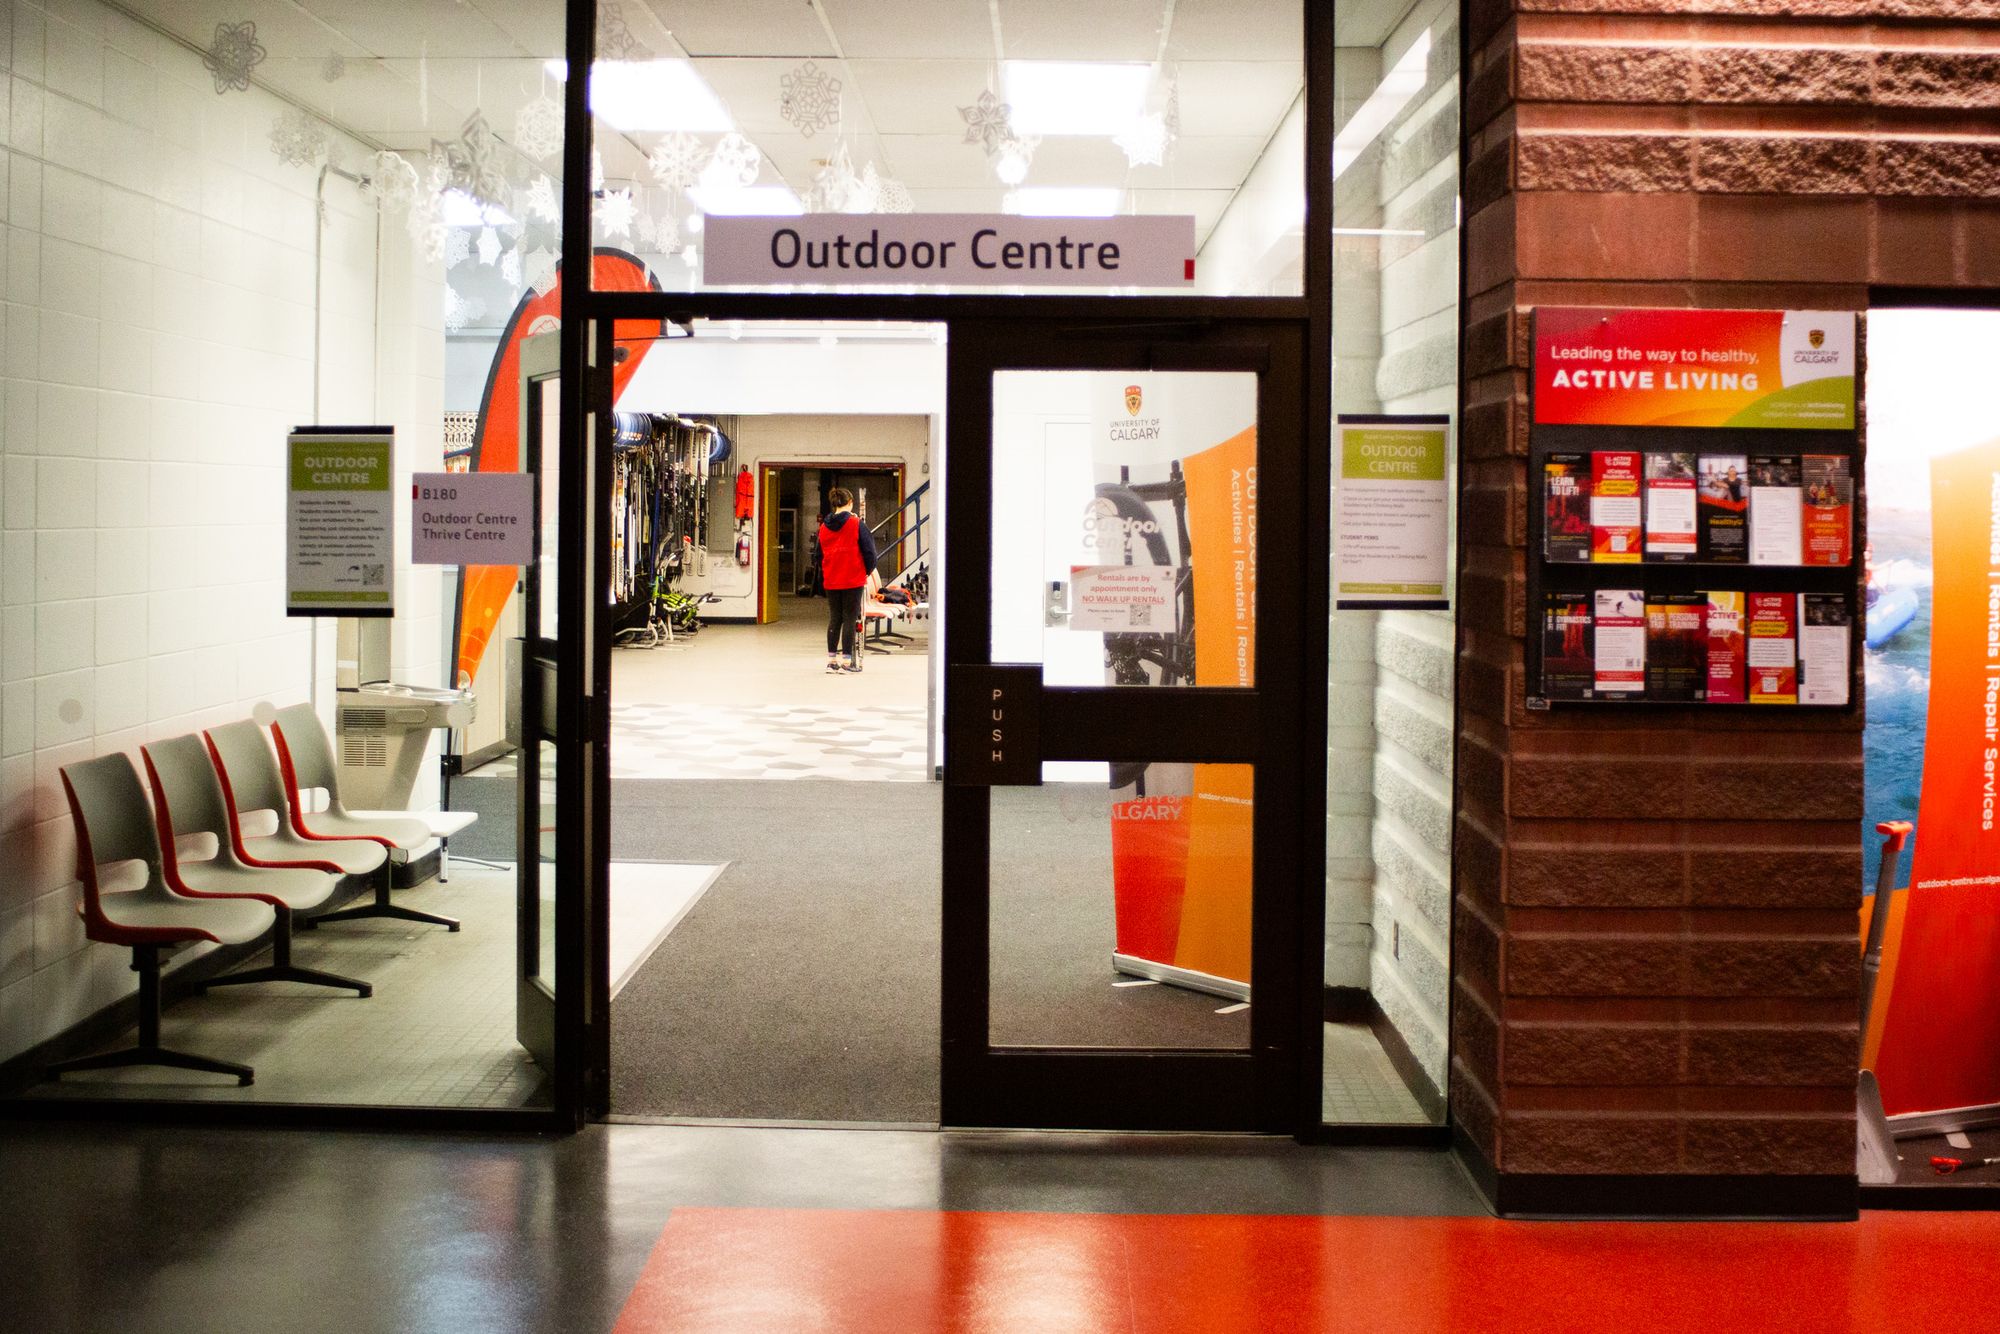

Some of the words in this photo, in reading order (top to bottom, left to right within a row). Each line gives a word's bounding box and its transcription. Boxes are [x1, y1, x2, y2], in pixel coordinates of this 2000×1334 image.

[771, 229, 956, 269] Outdoor
[971, 229, 1120, 270] Centre
[1551, 346, 1613, 363] Leading
[1616, 347, 1642, 360] the
[1646, 349, 1677, 364] way
[1681, 348, 1697, 361] to
[1701, 349, 1760, 364] healthy,
[1552, 370, 1655, 388] ACTIVE
[1665, 372, 1759, 391] LIVING
[1110, 419, 1149, 428] UNIVERSITY
[1151, 418, 1159, 426] OF
[1110, 428, 1160, 441] CALGARY
[1361, 445, 1427, 457] OUTDOOR
[304, 457, 378, 469] OUTDOOR
[1369, 461, 1418, 473] CENTRE
[312, 472, 369, 484] CENTRE
[1552, 477, 1575, 485] LEARN
[423, 488, 457, 500] B180
[1552, 487, 1560, 495] TO
[1232, 469, 1242, 544] Activities
[423, 512, 472, 524] Outdoor
[476, 513, 517, 524] Centre
[423, 528, 460, 540] Thrive
[465, 529, 505, 540] Centre
[1082, 534, 1147, 548] Cent
[1141, 575, 1150, 583] by
[1235, 560, 1246, 621] Rentals
[1988, 584, 2000, 658] Rentals
[1984, 677, 2000, 741] Repair
[993, 689, 1002, 762] PUSH
[1982, 748, 1999, 831] Services
